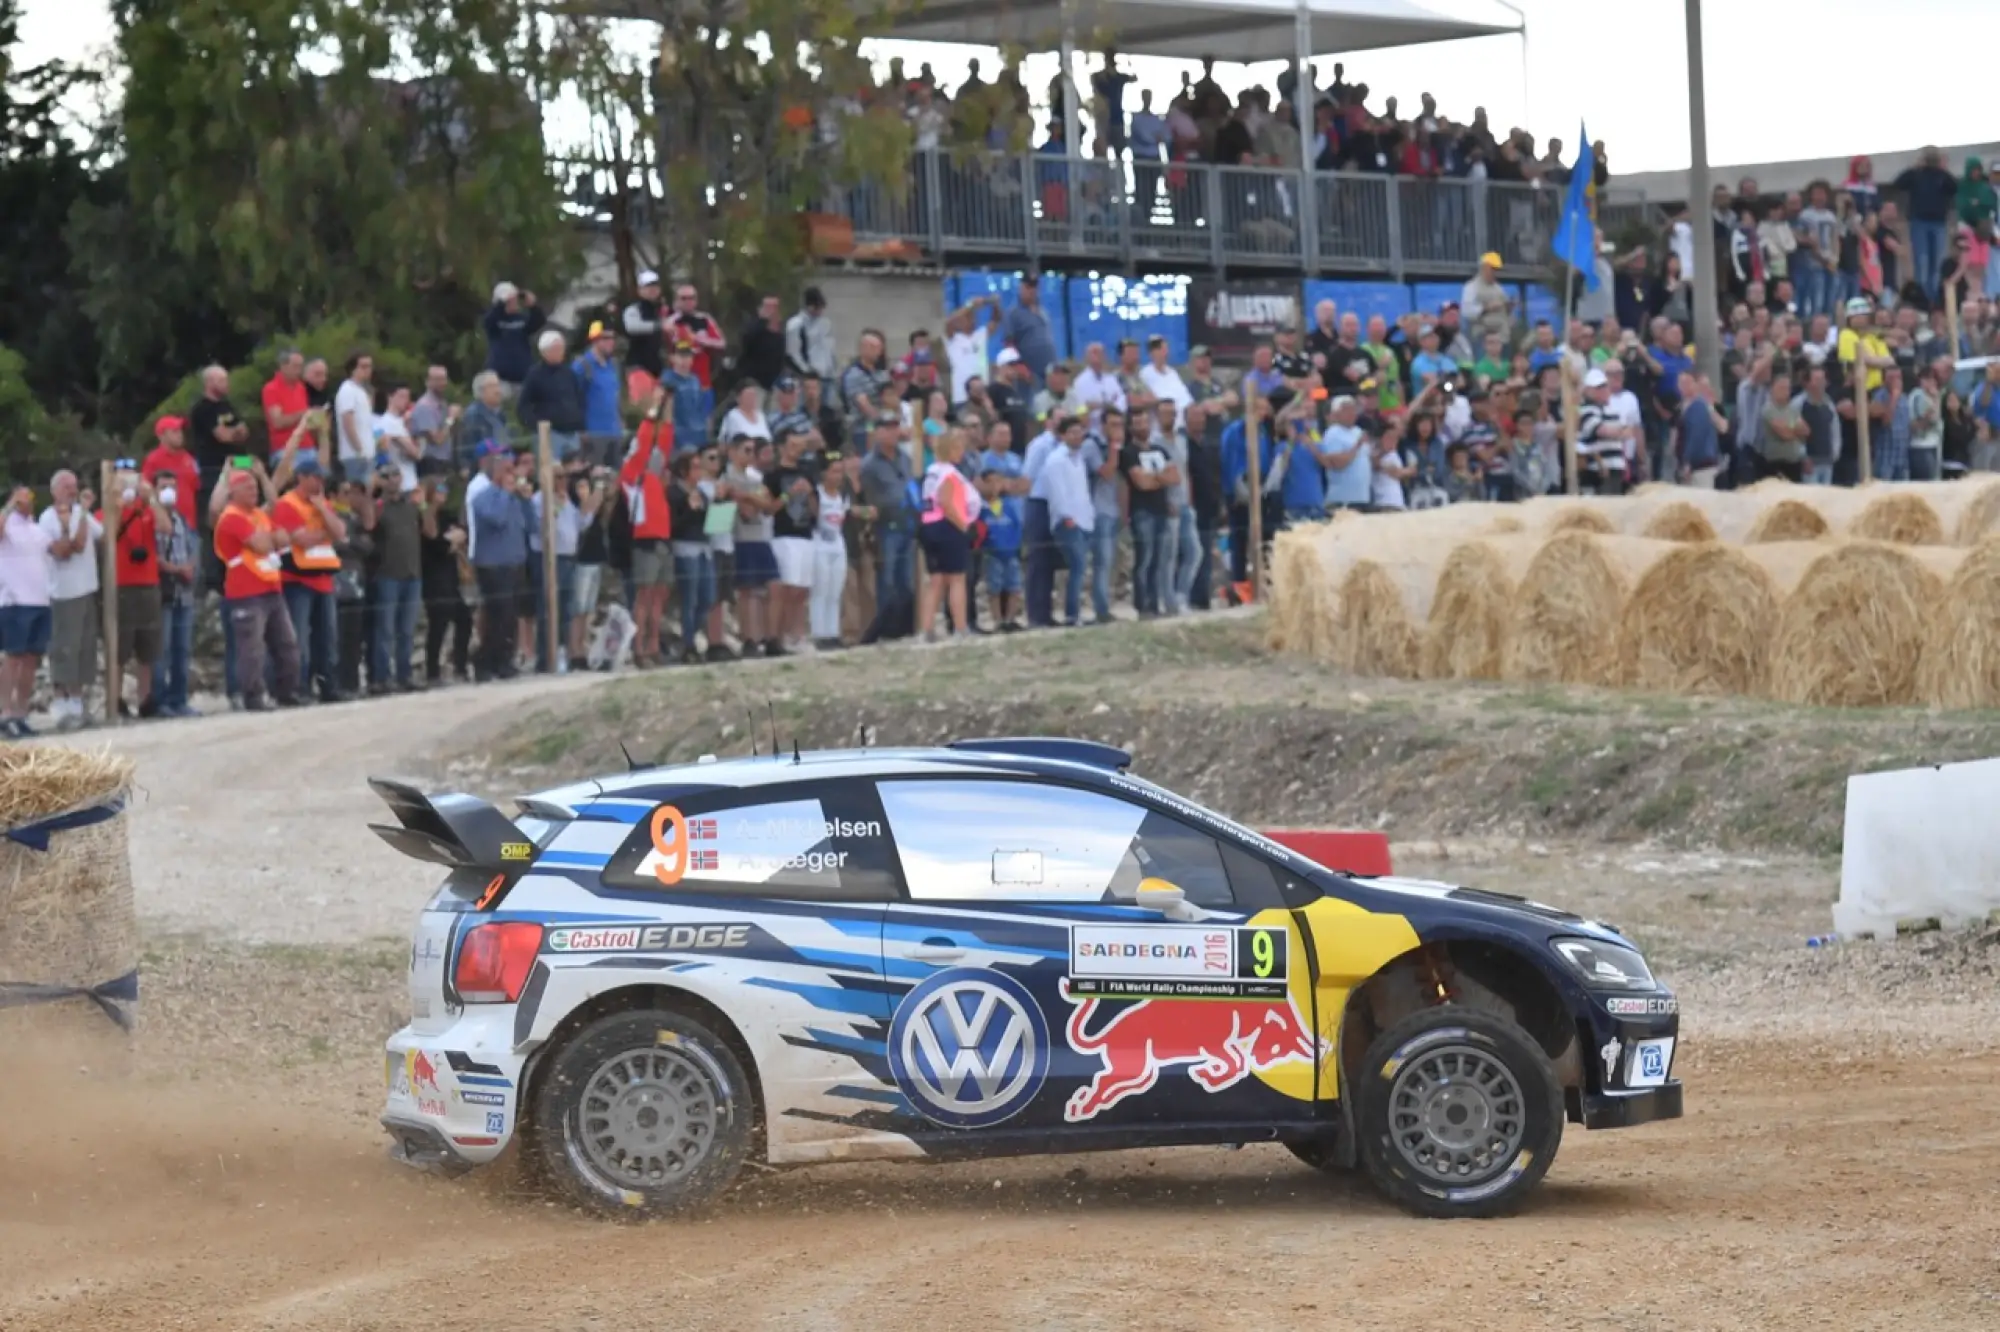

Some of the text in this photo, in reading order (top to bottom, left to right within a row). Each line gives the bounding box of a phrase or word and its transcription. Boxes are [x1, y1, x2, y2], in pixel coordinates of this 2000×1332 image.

[766, 817, 882, 838] Mkkelsen
[501, 846, 531, 858] OMP
[650, 804, 688, 885] 9
[474, 872, 506, 912] 9
[569, 925, 751, 949] Castrol EDGE
[1079, 943, 1198, 959] SARDEGNA
[1204, 934, 1228, 971] 2016
[1252, 929, 1275, 977] 9
[1110, 982, 1236, 995] FIA World Rally Championship
